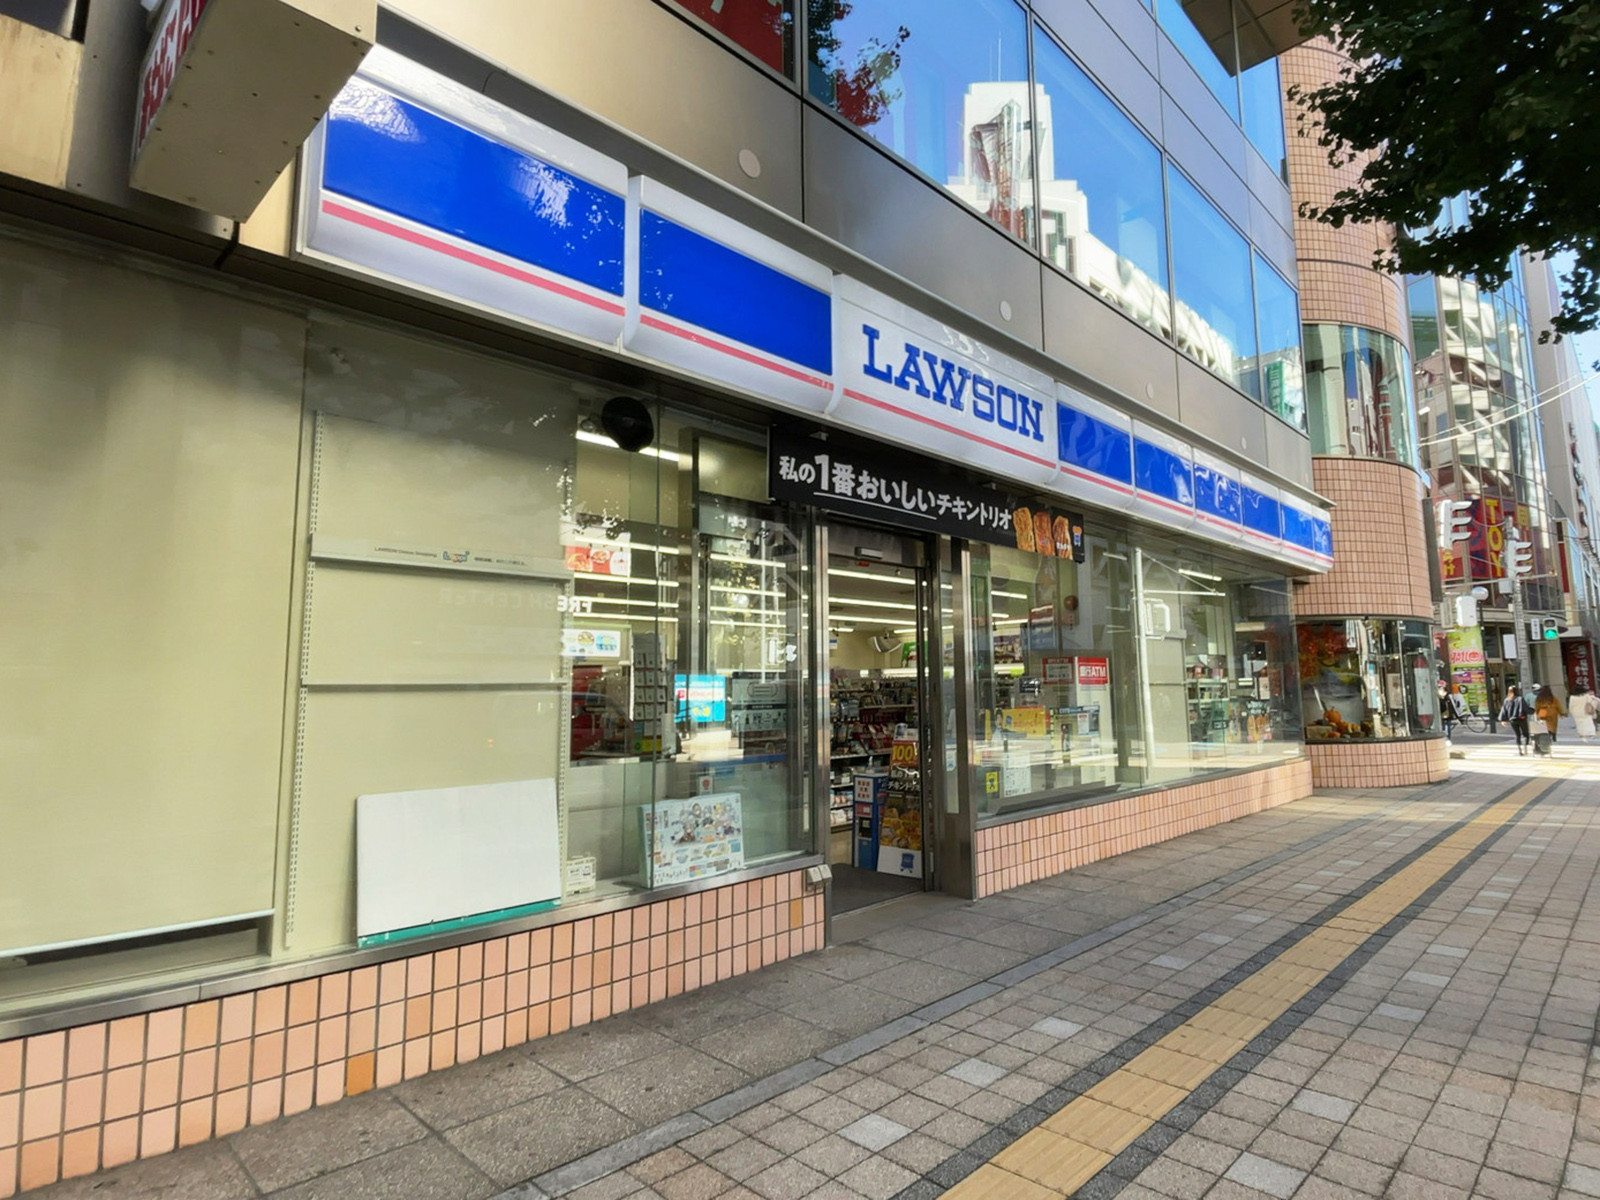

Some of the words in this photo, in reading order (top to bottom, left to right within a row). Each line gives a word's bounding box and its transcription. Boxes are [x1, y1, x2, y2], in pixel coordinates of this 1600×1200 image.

[862, 323, 1044, 443] LAWSON
[779, 454, 1012, 531] 私の1番おいしいチキントリオ
[1485, 499, 1504, 577] TOY
